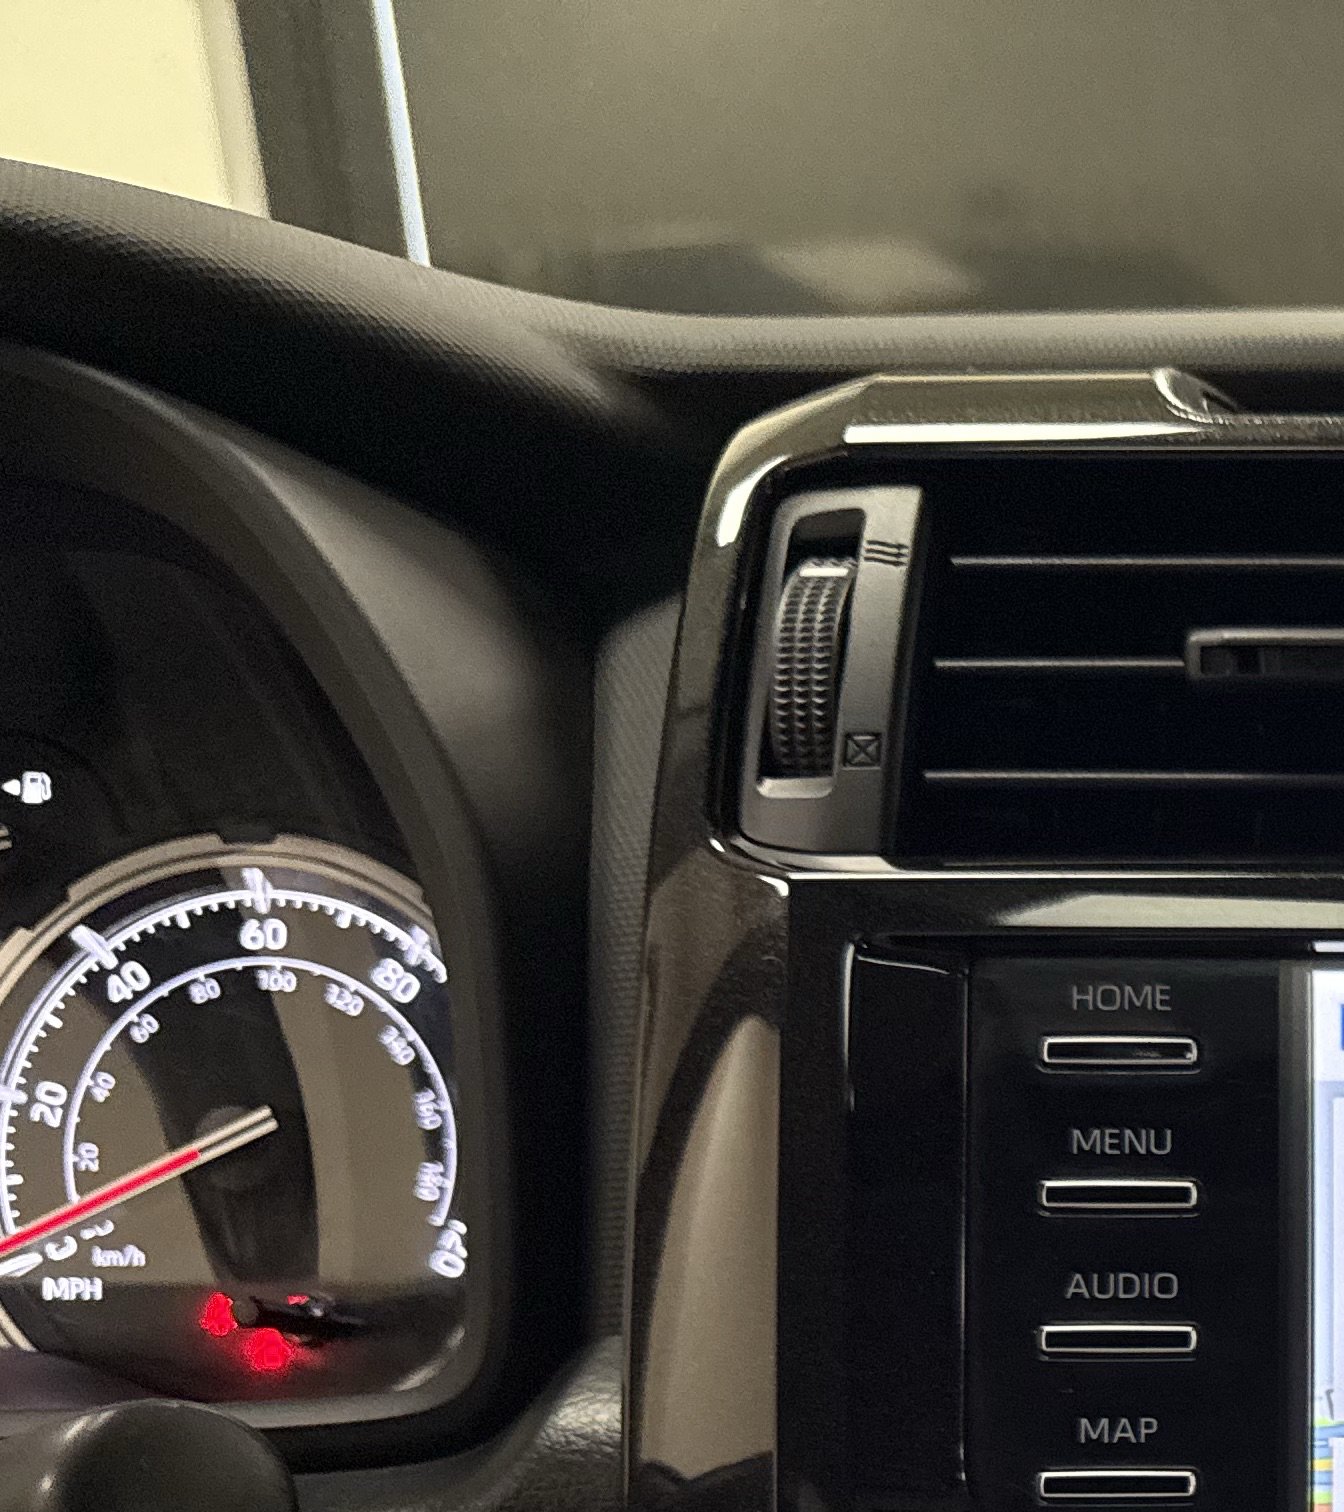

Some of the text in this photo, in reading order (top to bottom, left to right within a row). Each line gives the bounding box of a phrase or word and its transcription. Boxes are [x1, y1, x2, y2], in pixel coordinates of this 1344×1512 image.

[239, 918, 288, 951] 60
[107, 960, 150, 1003] 40
[370, 957, 421, 1004] 80
[1072, 985, 1172, 1011] HOME
[129, 1013, 160, 1044] 60
[30, 1081, 68, 1128] 20
[1072, 1129, 1172, 1155] MENU
[92, 1243, 146, 1267] km/h
[41, 1276, 103, 1301] MPH
[1066, 1272, 1179, 1299] AUDIO
[1079, 1418, 1159, 1444] MAP
